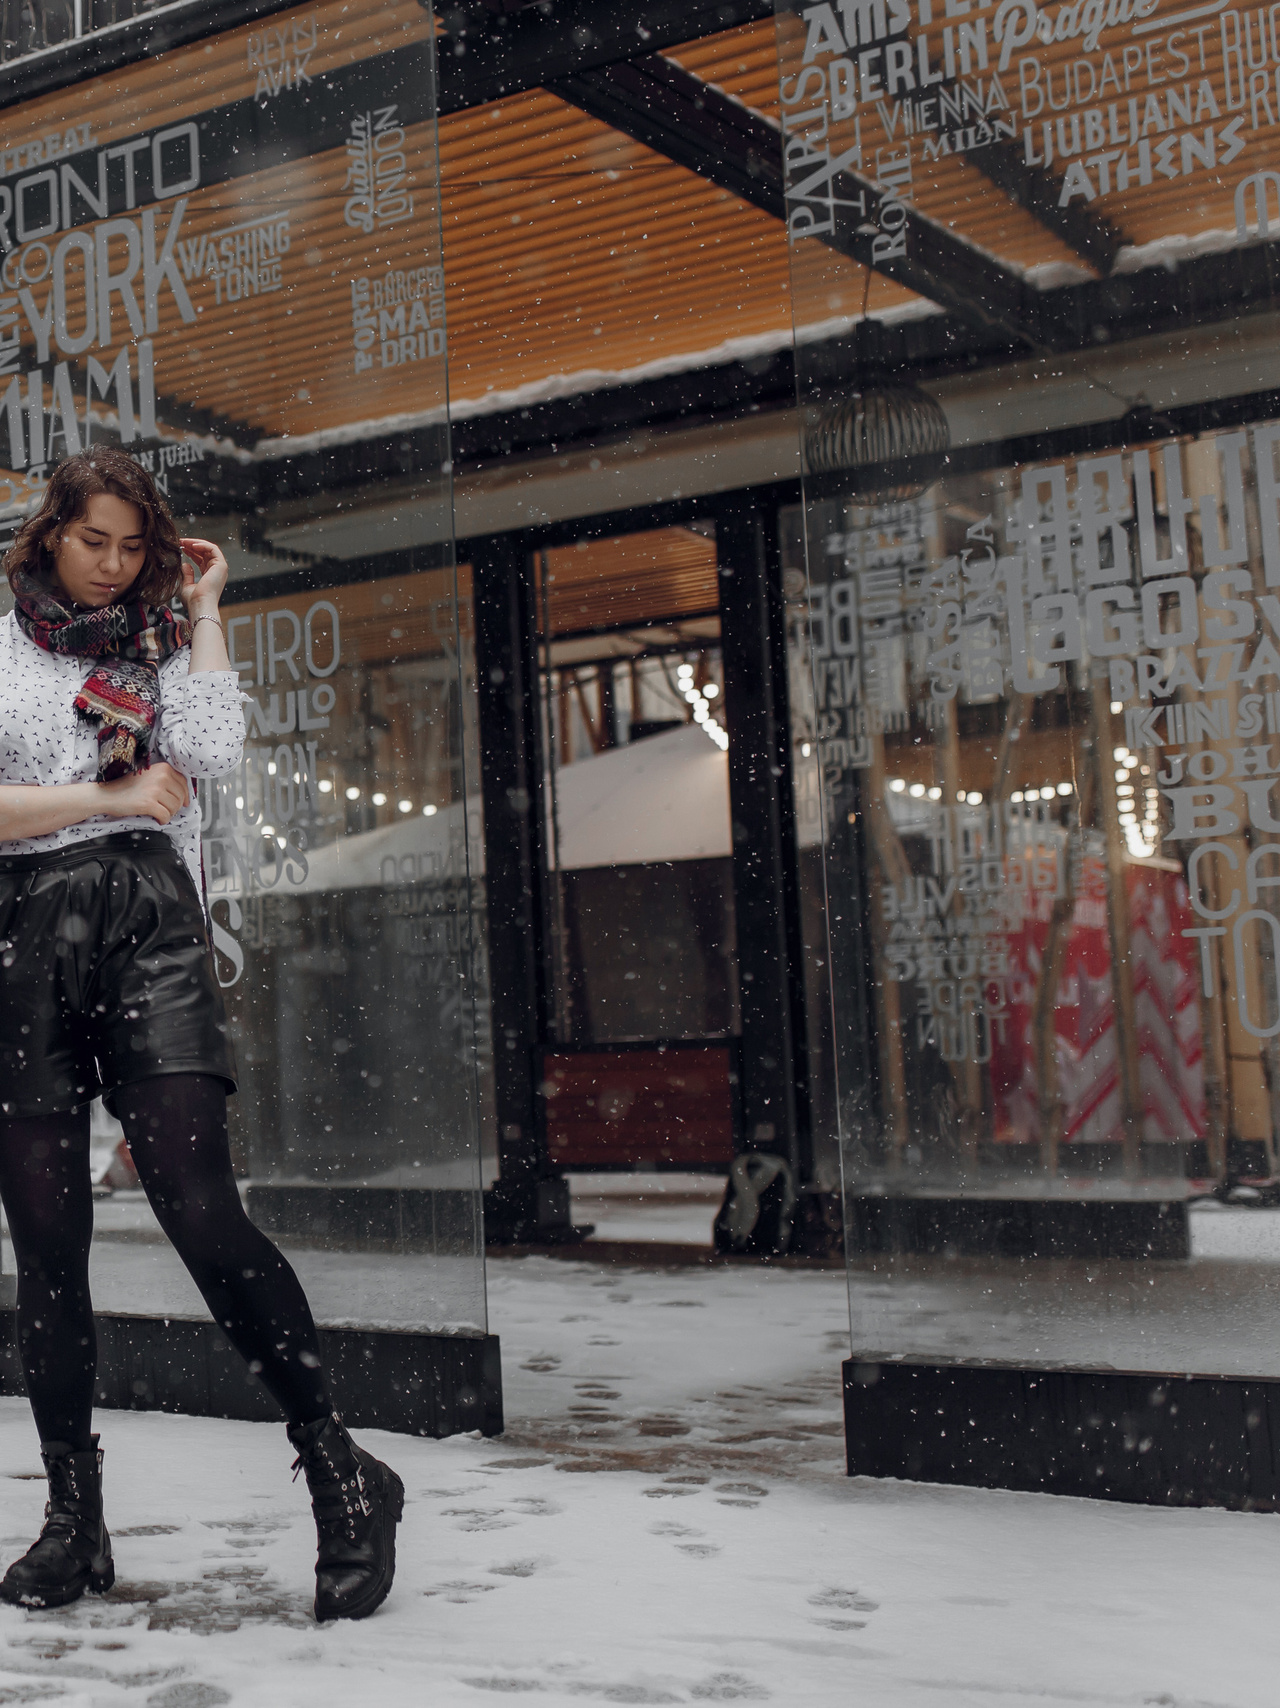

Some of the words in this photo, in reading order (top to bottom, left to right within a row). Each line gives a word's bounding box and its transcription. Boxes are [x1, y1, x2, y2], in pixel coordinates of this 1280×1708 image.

[247, 14, 318, 71] REYKJ
[255, 53, 314, 101] AVIK
[829, 17, 989, 122] BERLIN
[1020, 24, 1213, 119] BUDAPEST
[875, 70, 1011, 143] VIENNA
[921, 110, 1019, 161] MILAN
[1022, 79, 1220, 169] LJUBLJANA
[343, 112, 375, 233] Dublin
[372, 104, 415, 228] LONDON
[779, 65, 866, 247] PARIS
[1057, 116, 1247, 208] ATHENS
[872, 140, 914, 266] ROME
[18, 197, 197, 363] YORK
[379, 300, 430, 343] MA
[350, 276, 379, 375] PORTO
[381, 328, 447, 368] DRID
[156, 441, 206, 478] JUAN
[227, 600, 341, 690] EIRO
[244, 682, 337, 741] AULO
[1156, 744, 1280, 787] JOH
[202, 827, 310, 896] ENOS
